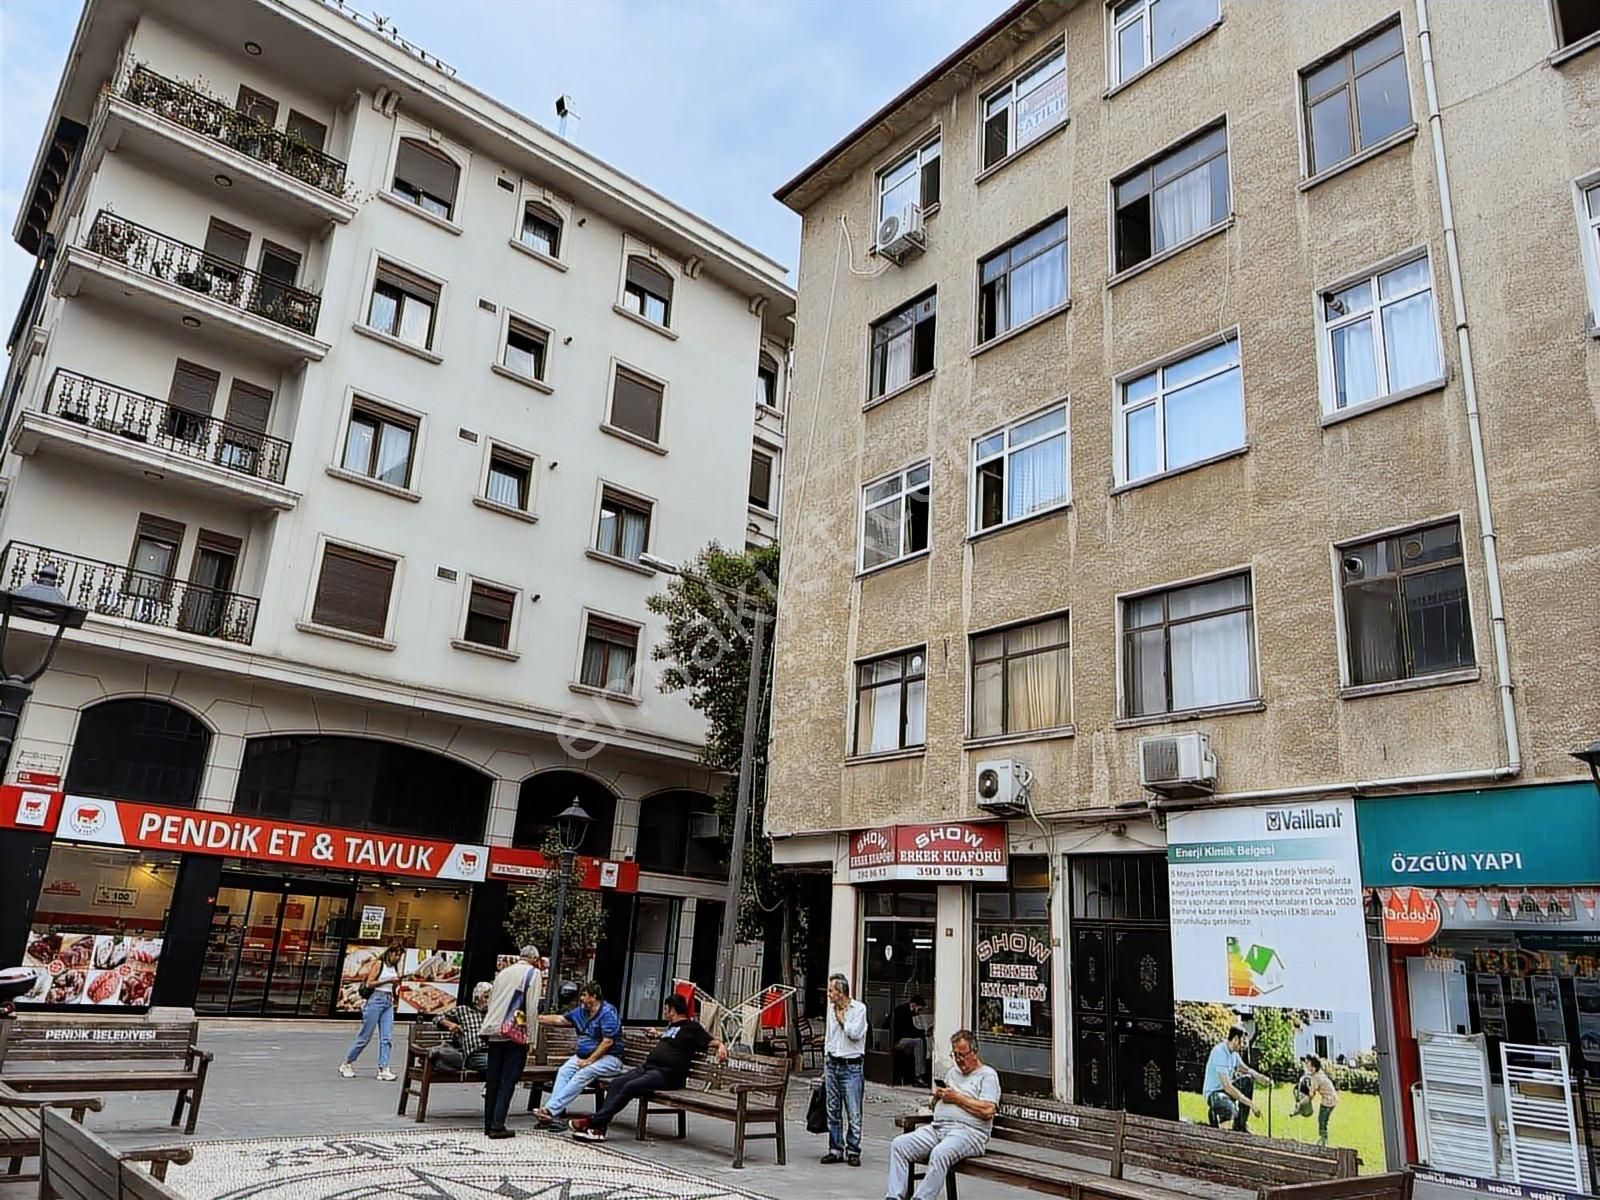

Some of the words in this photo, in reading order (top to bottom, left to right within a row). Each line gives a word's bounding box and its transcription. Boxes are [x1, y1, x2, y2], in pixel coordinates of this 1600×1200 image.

[1281, 807, 1343, 830] Vaillant
[857, 832, 887, 854] SHOW
[915, 827, 983, 849] SHOW
[268, 828, 305, 857] ET
[311, 833, 334, 861] &
[345, 836, 435, 871] TAVUK
[900, 850, 940, 862] ERKEK
[943, 848, 1000, 863] KUAFÖRÜ
[1175, 847, 1203, 859] Enerji
[1204, 846, 1235, 857] Kimlik
[1237, 845, 1275, 858] Belgesi
[917, 867, 941, 876] 390
[945, 867, 962, 876] 96
[967, 867, 984, 877] 13
[1391, 851, 1467, 872] ÖZGÜN
[1471, 852, 1522, 870] YAPI
[976, 932, 1051, 964] SHOW
[989, 963, 1038, 980] ERKEK
